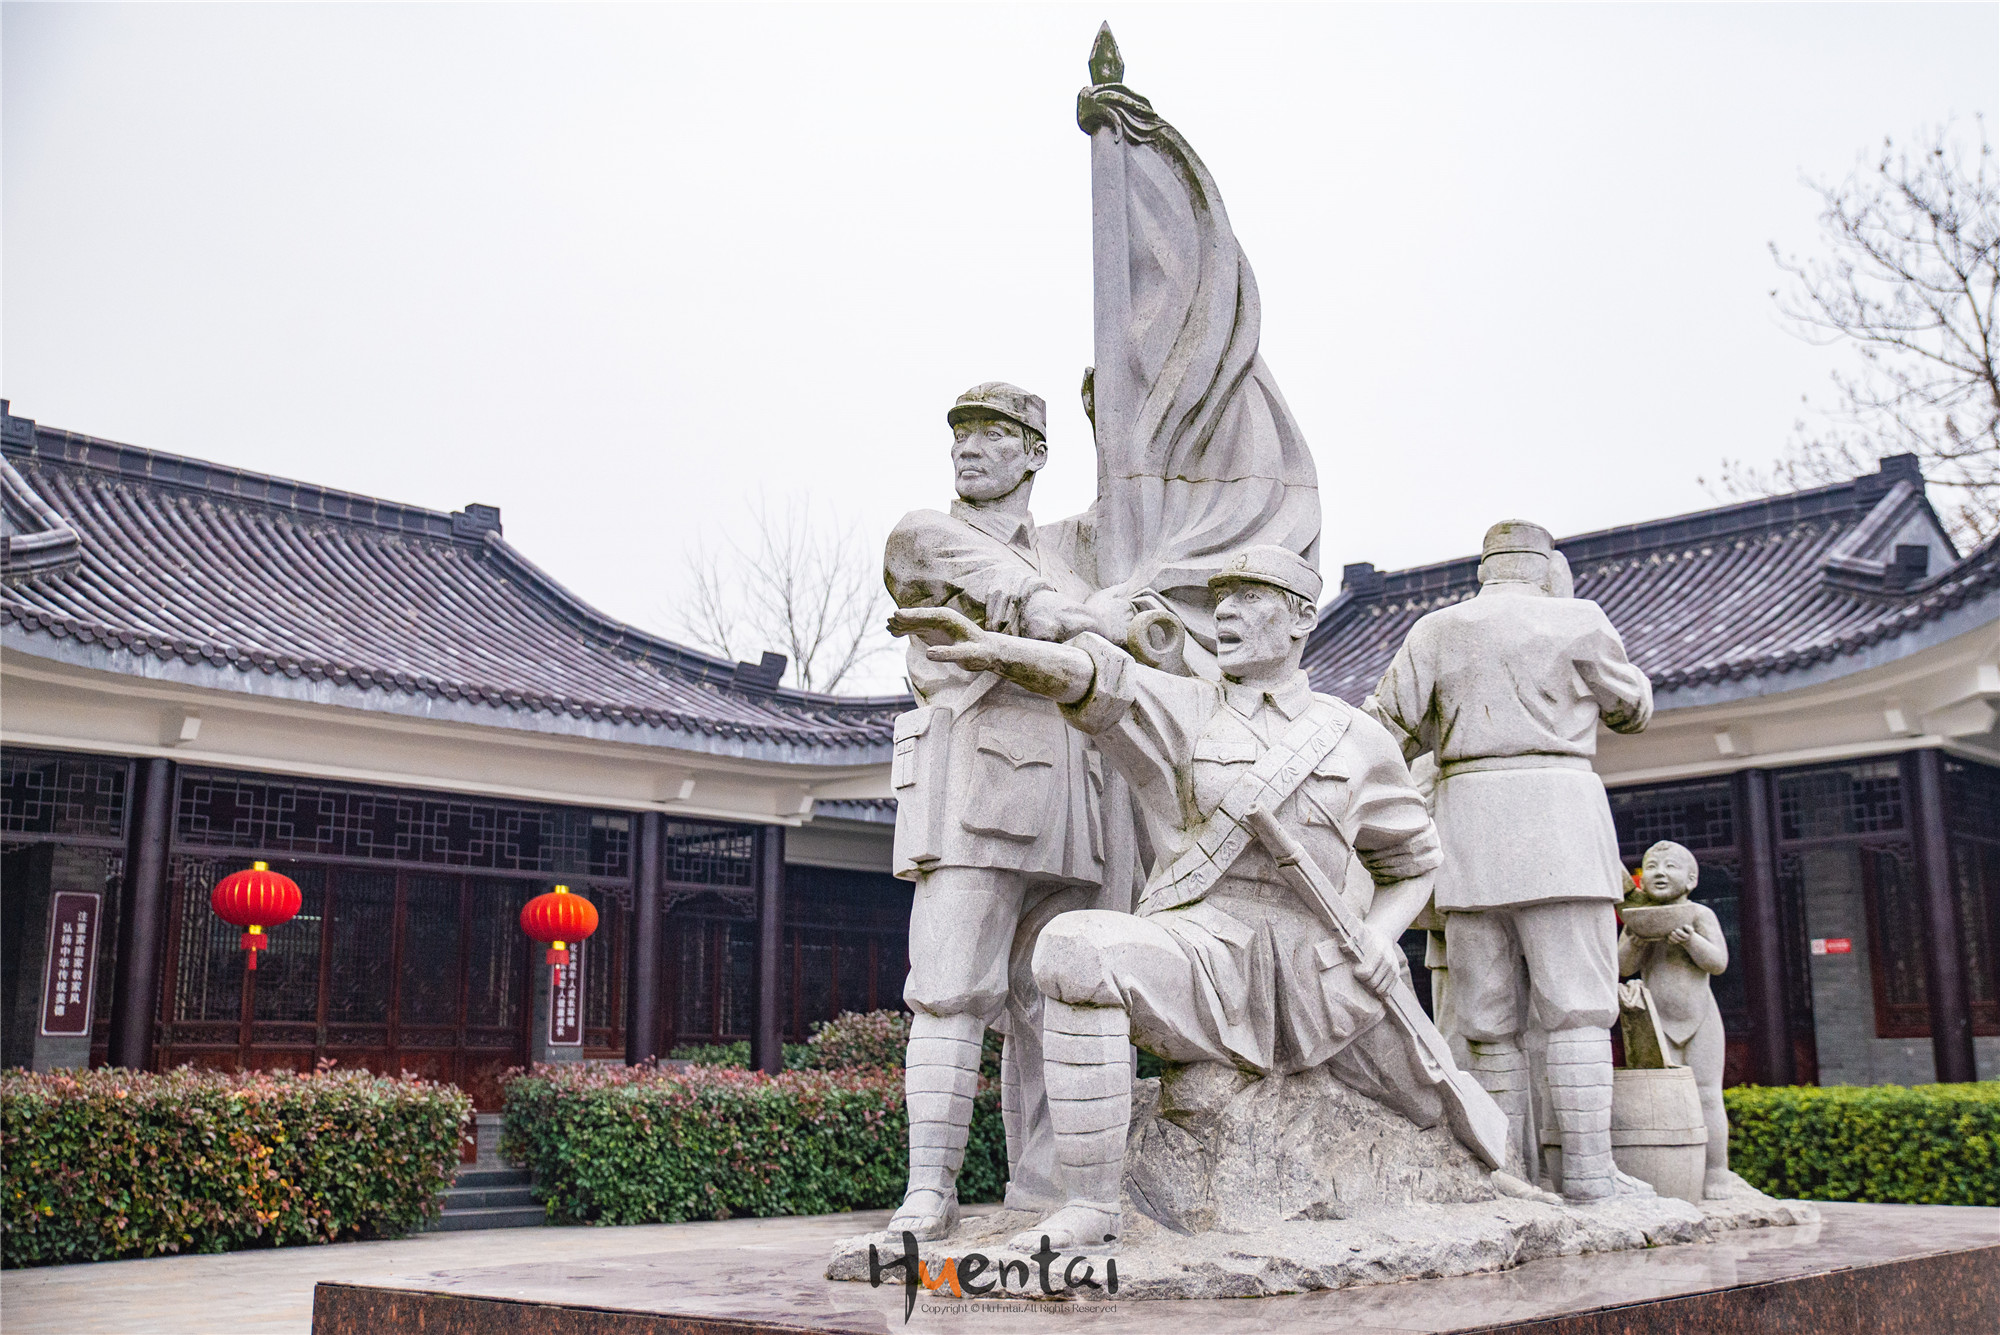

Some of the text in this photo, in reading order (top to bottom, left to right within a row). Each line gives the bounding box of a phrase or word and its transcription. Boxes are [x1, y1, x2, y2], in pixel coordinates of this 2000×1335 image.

[54, 922, 72, 1016] 弘扬中华传统美德
[69, 911, 87, 1003] 注重家庭家教家风
